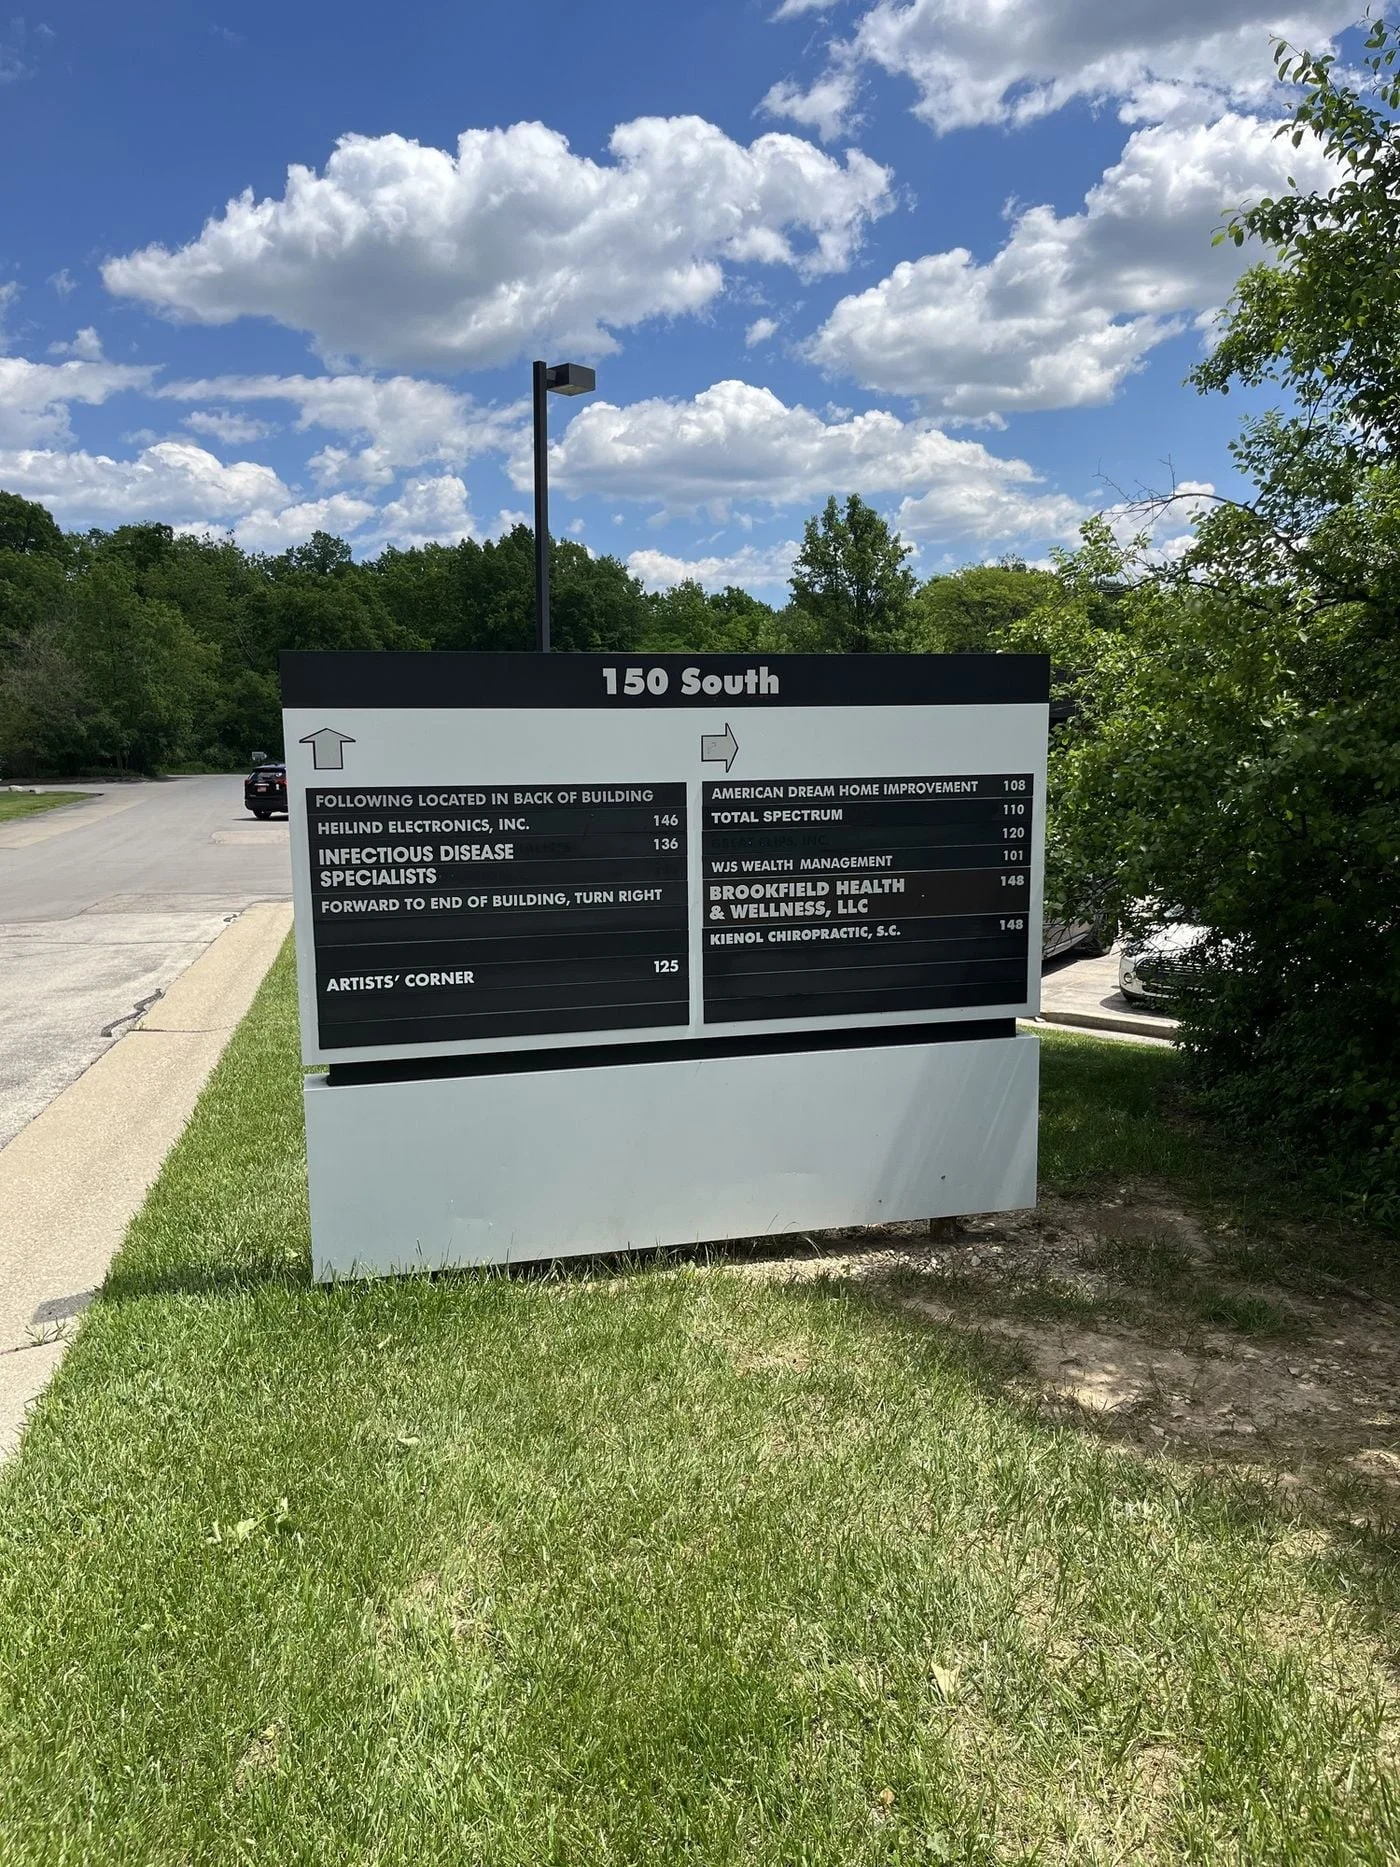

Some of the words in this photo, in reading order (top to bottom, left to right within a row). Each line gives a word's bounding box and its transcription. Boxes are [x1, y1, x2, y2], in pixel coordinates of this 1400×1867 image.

[603, 668, 668, 695] 150
[681, 667, 779, 695] South
[712, 787, 783, 799] AMERICAN
[788, 785, 835, 797] DREAM
[840, 784, 879, 796] HOME
[884, 781, 978, 795] IMPROVEMENT
[1004, 780, 1025, 791] 108
[316, 795, 413, 807] FOLLOWING
[419, 794, 486, 806] LOCATED
[492, 793, 508, 804] IN
[514, 792, 553, 804] BACK
[558, 792, 577, 803] OF
[582, 790, 653, 803] BUILDING
[711, 812, 759, 823] TOTAL
[763, 809, 842, 822] SPECTRUM
[1004, 804, 1024, 814] 110
[318, 822, 383, 834] HEILIND
[389, 819, 493, 833] ELECTRONICS,
[499, 818, 529, 830] INC.
[654, 815, 678, 826] 146
[1003, 828, 1024, 838] 120
[654, 838, 678, 850] 136
[319, 846, 433, 865] INFECTIOUS
[440, 844, 513, 861] DISEASE
[1004, 851, 1022, 860] 101
[712, 861, 737, 872] WJS
[741, 860, 793, 871] WEALTH
[800, 856, 892, 869] MANAGEMENT
[321, 868, 436, 887] SPECIALISTS
[1000, 875, 1024, 886] 148
[710, 882, 829, 900] BROOKFIELD
[837, 879, 904, 895] HEALTH
[322, 899, 399, 913] FORWARD
[404, 898, 425, 910] TO
[431, 897, 462, 909] END
[468, 896, 487, 908] OF
[493, 893, 570, 907] BUILDING,
[575, 891, 613, 903] TURN
[619, 889, 662, 902] RIGHT
[710, 905, 725, 920] &
[730, 901, 831, 918] WELLNESS,
[838, 899, 868, 914] LLC
[999, 920, 1023, 930] 148
[711, 932, 763, 945] KIENOL
[768, 927, 872, 942] CHIROPRACTIC,
[877, 925, 900, 936] S.C.
[654, 960, 679, 972] 125
[405, 971, 474, 987] CORNER
